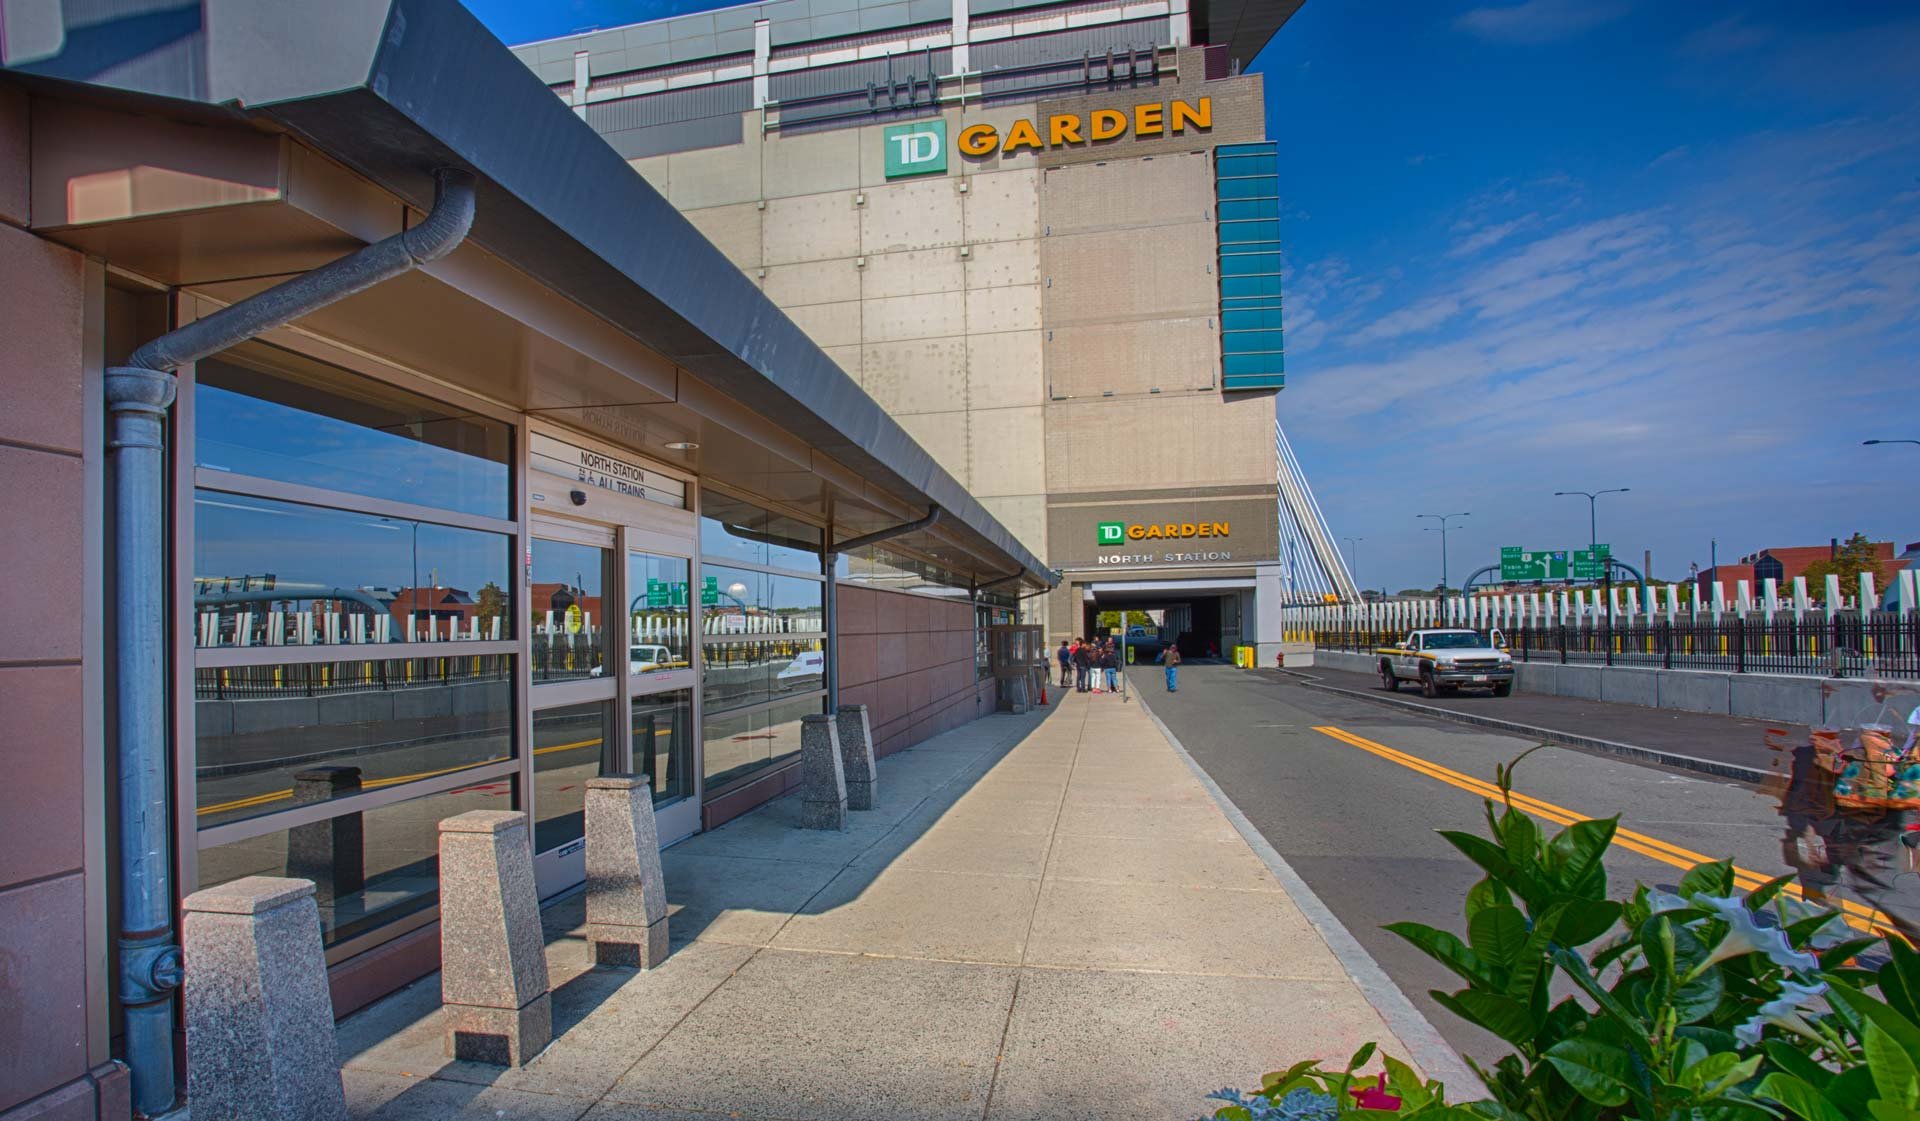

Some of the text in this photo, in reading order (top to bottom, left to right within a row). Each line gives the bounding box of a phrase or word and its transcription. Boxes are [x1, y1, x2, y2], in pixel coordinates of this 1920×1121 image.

[890, 96, 1213, 165] TD GARDEN
[580, 451, 645, 483] NORTH STATION
[616, 480, 646, 499] TRAINS
[1100, 520, 1230, 539] TD GARDEN
[1098, 551, 1231, 564] NORTH STATION
